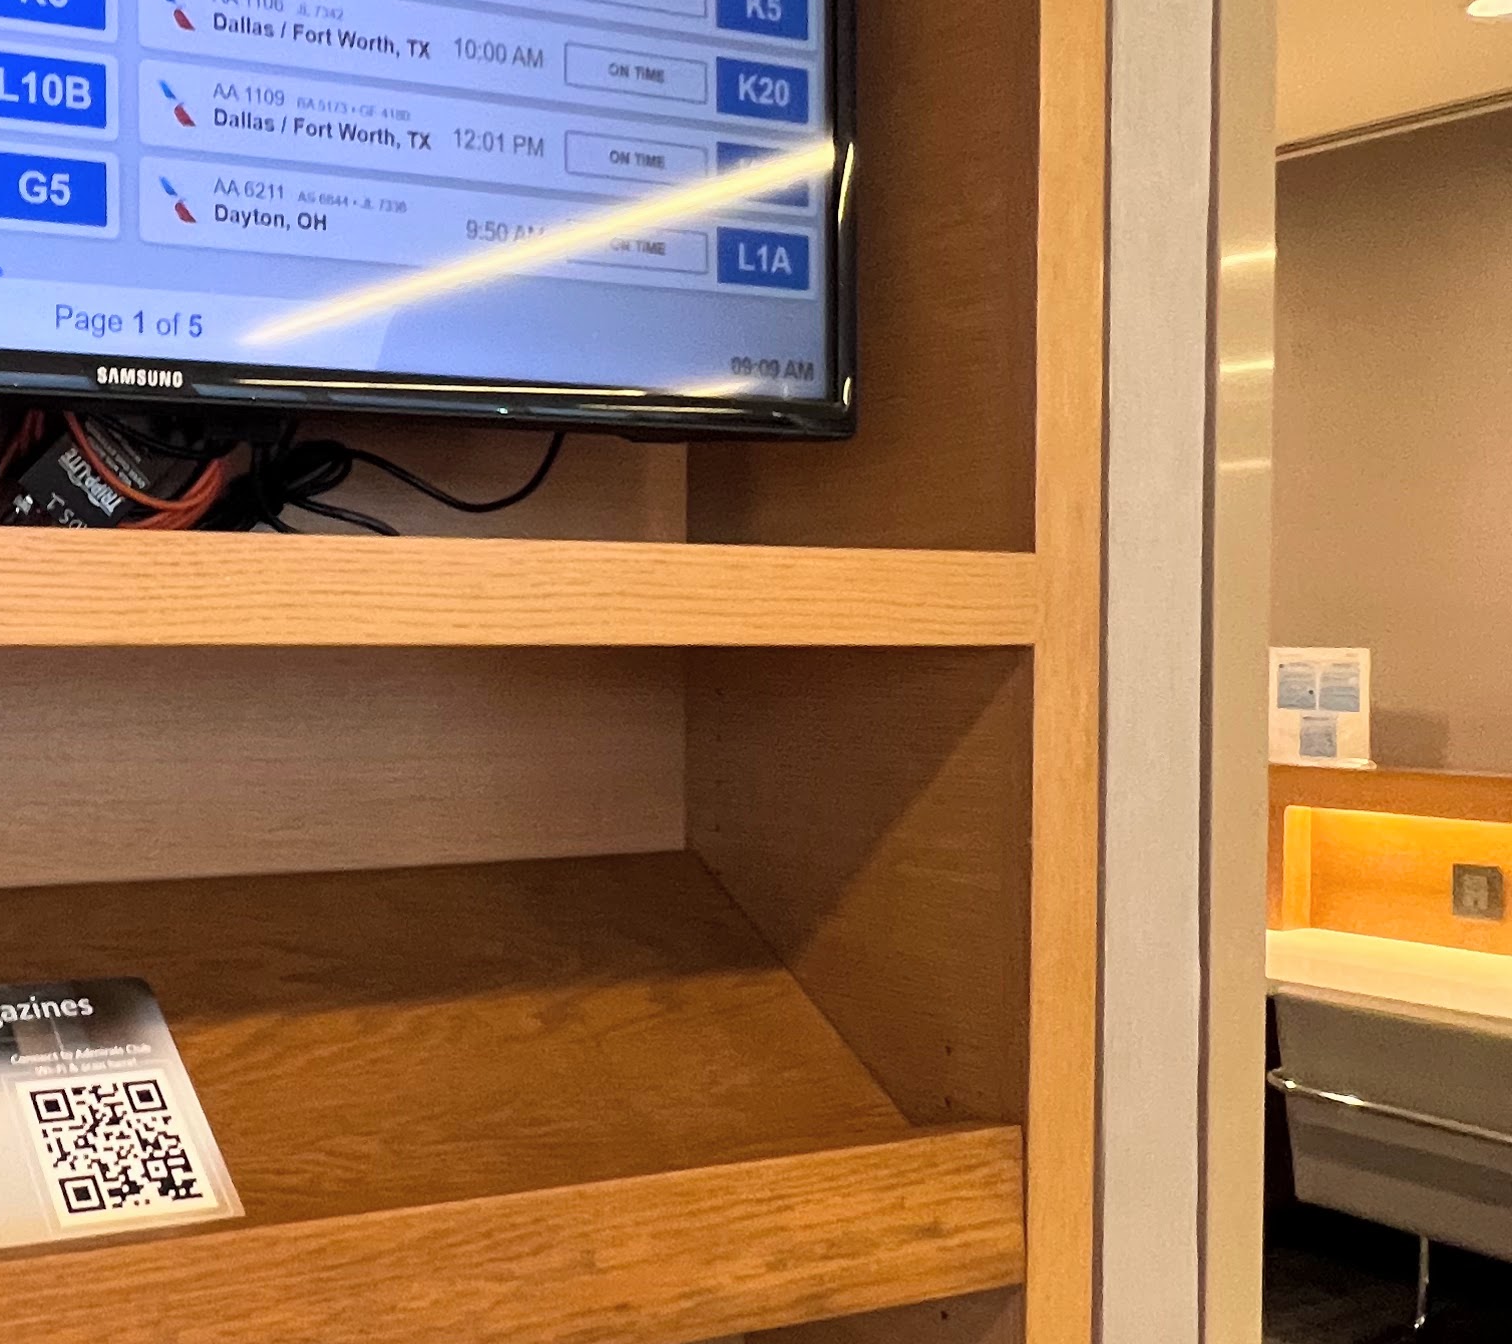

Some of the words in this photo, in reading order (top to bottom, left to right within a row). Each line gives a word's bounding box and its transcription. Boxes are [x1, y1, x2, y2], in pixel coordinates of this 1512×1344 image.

[213, 12, 274, 39] Dallas
[292, 23, 332, 47] Fort
[337, 30, 400, 59] Worth,
[406, 39, 431, 60] TX
[213, 83, 239, 102] AA
[245, 87, 285, 107] 1109
[738, 75, 789, 107] K20
[454, 128, 505, 153] 12:01
[512, 134, 544, 158] PM
[18, 168, 71, 208] G5
[214, 177, 240, 197] AA
[244, 180, 284, 201] 6211
[215, 204, 290, 232] Dayton,
[297, 212, 327, 232] OH
[738, 243, 791, 275] L1A
[55, 303, 122, 338] Page
[132, 311, 145, 335] 1
[156, 311, 183, 337] of
[187, 312, 204, 338] 5
[783, 360, 814, 382] AM
